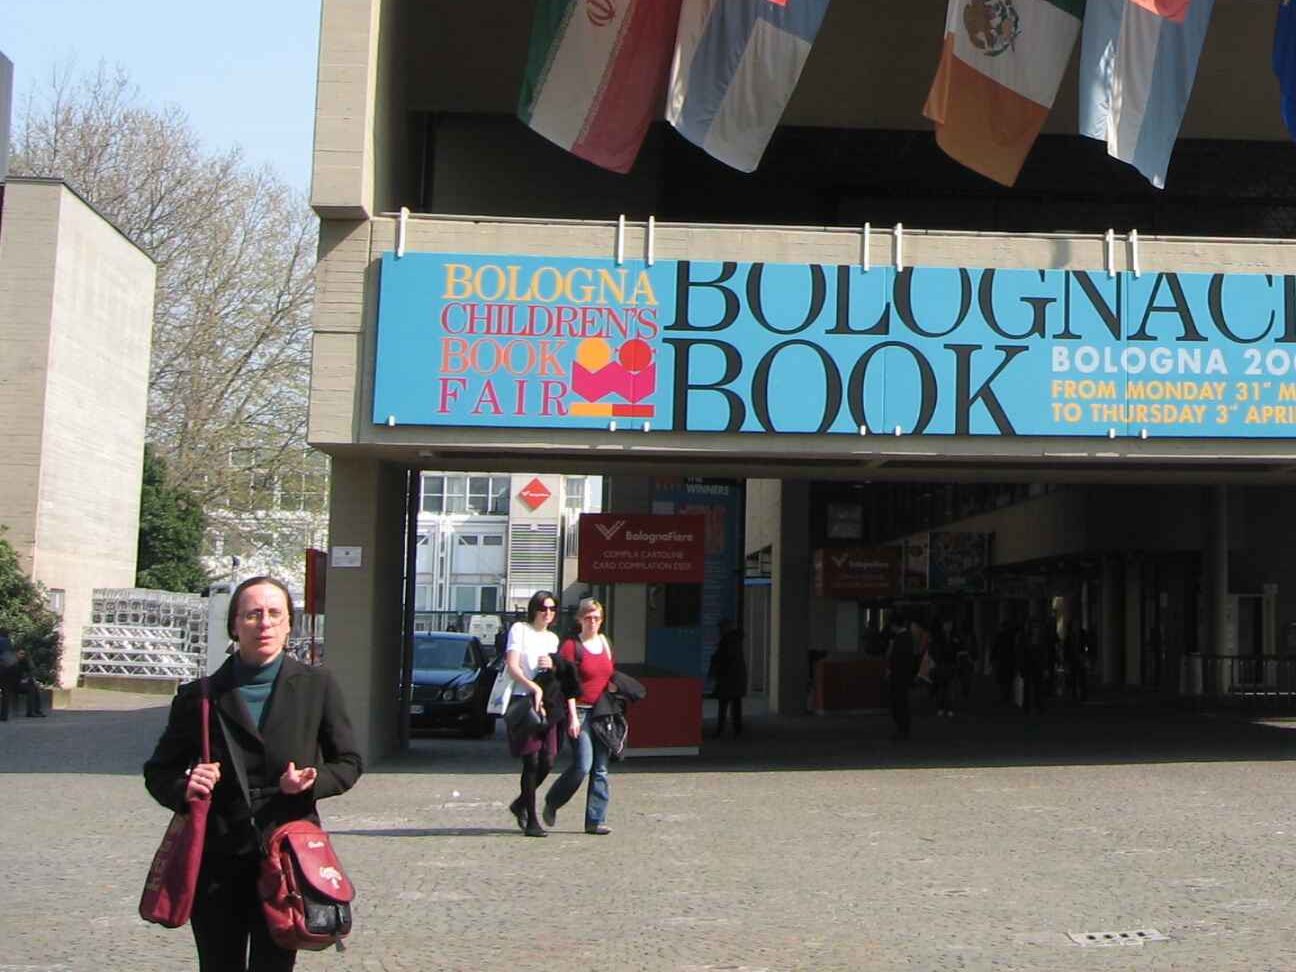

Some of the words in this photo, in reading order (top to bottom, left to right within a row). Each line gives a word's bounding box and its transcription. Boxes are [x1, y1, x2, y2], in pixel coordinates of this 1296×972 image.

[443, 263, 659, 306] BOLOGNA
[440, 302, 659, 340] CHILDREN'S
[439, 336, 567, 376] BOOK
[1051, 346, 1228, 374] BOLOGNA
[438, 378, 569, 417] FAIR
[662, 338, 1029, 436] BOOK
[1051, 380, 1117, 399] FROM
[1127, 381, 1227, 401] MONDAY
[1051, 403, 1082, 422] TO
[1091, 404, 1207, 424] THURSDAY
[625, 530, 694, 544] BolognaFiere
